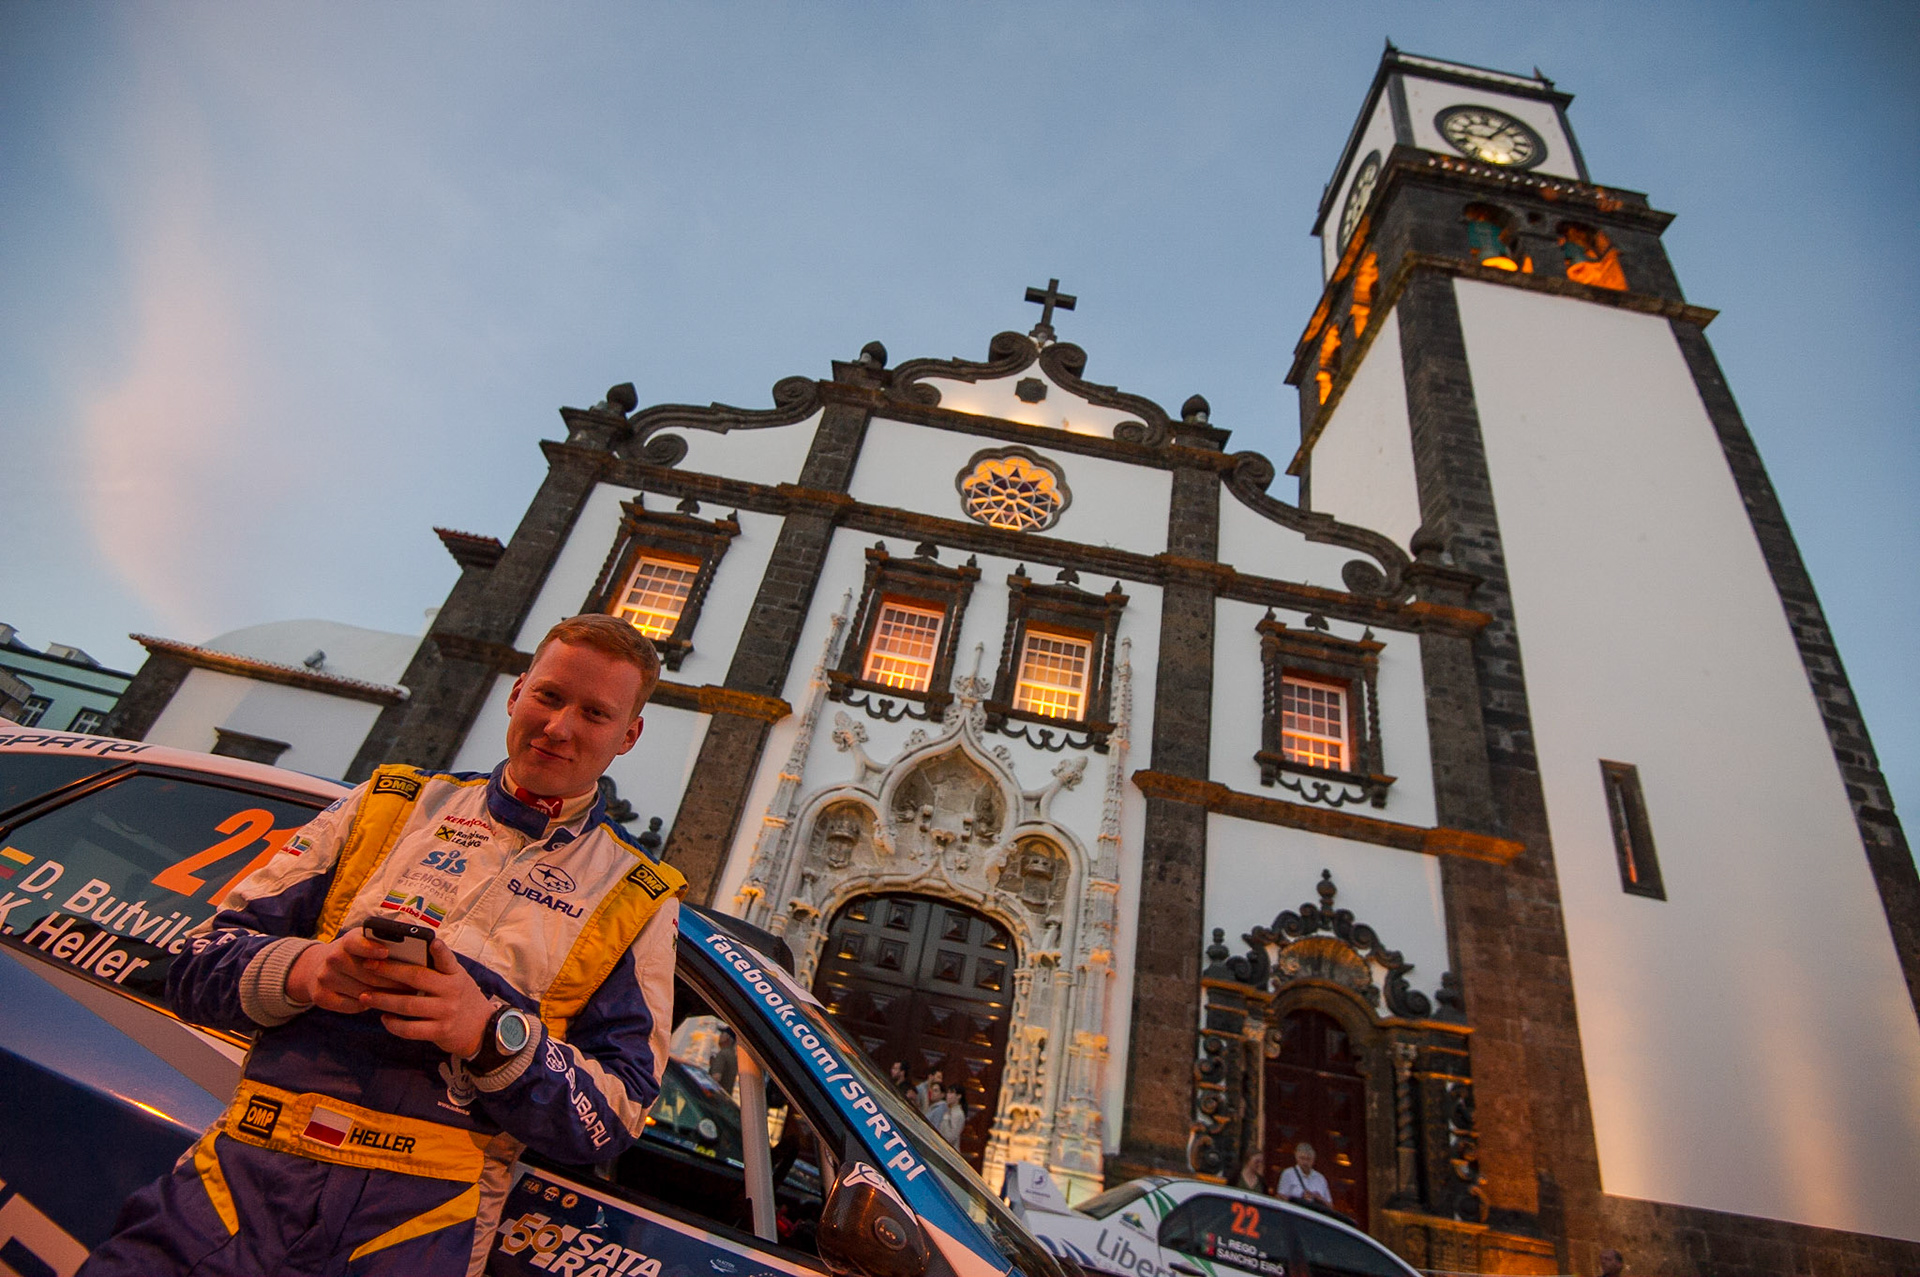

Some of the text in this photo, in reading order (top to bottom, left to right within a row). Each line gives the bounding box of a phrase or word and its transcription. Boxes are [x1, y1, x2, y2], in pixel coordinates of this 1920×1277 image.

[379, 779, 415, 792] OMP
[17, 860, 64, 900] D.
[507, 878, 584, 919] SUBARU
[635, 869, 663, 891] OMP
[22, 911, 149, 984] Heller
[246, 1105, 275, 1128] OMP
[565, 1067, 611, 1150] SUBARU
[350, 1127, 417, 1154] HELLER
[503, 1212, 564, 1254] 50
[1231, 1201, 1260, 1239] 22
[568, 1233, 662, 1277] SATA
[1228, 1239, 1258, 1255] REGO
